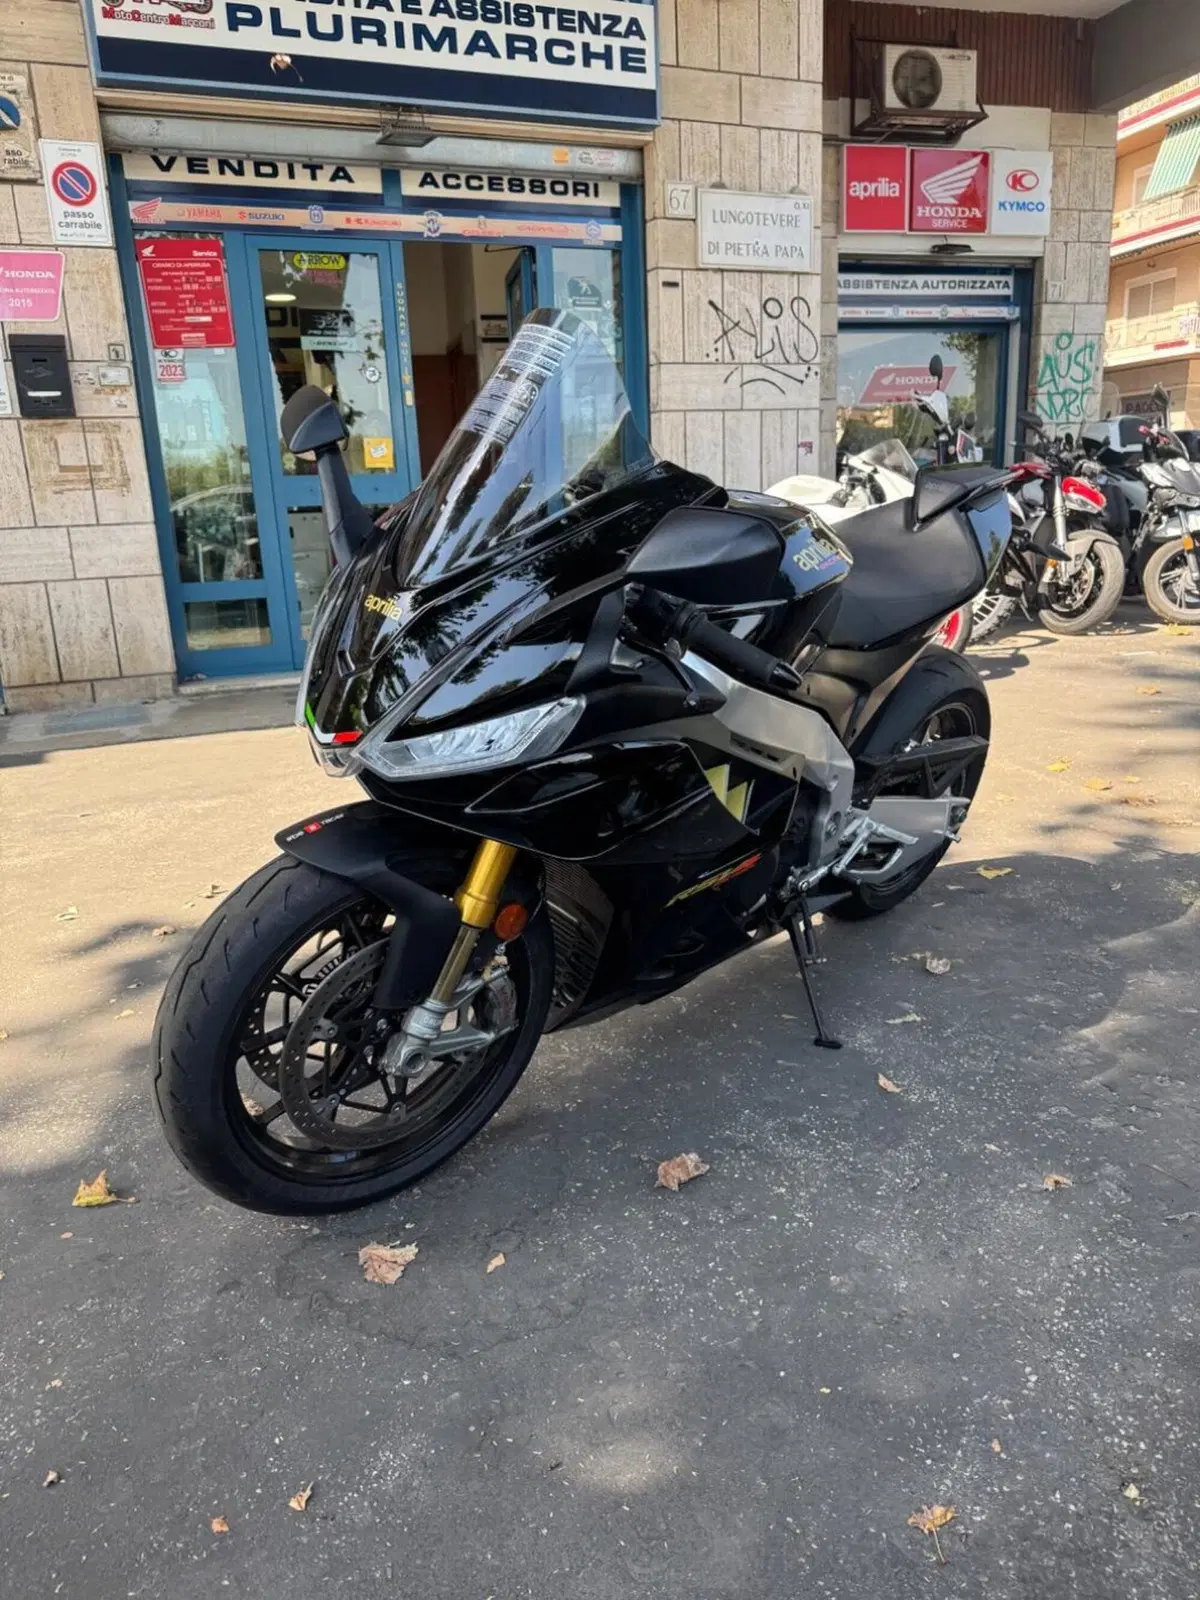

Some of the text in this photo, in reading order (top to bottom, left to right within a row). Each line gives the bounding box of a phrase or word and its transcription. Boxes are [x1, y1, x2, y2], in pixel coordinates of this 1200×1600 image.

[428, 0, 647, 41] ASSISTENZA
[225, 2, 648, 74] PLURIMARCHE
[150, 155, 355, 184] VENDITA
[418, 171, 600, 198] ACCESSORI
[849, 177, 901, 200] aprilia
[669, 187, 691, 211] 67
[916, 205, 984, 219] HONDA
[998, 200, 1046, 213] KYMCO
[63, 210, 95, 220] passo
[247, 212, 286, 222] SUZUKI
[711, 208, 801, 229] LUNGOTEVERE
[58, 221, 103, 230] carrabile
[931, 219, 968, 229] SERVICE
[192, 249, 218, 257] Service
[707, 241, 806, 260] DI PIETRA PAPA
[297, 252, 341, 265] ARROW
[4, 269, 56, 279] HONDA
[920, 279, 1012, 291] AUTORIZZATA
[159, 364, 185, 377] 2023
[792, 537, 839, 571] aprilia
[364, 594, 402, 621] aprilia
